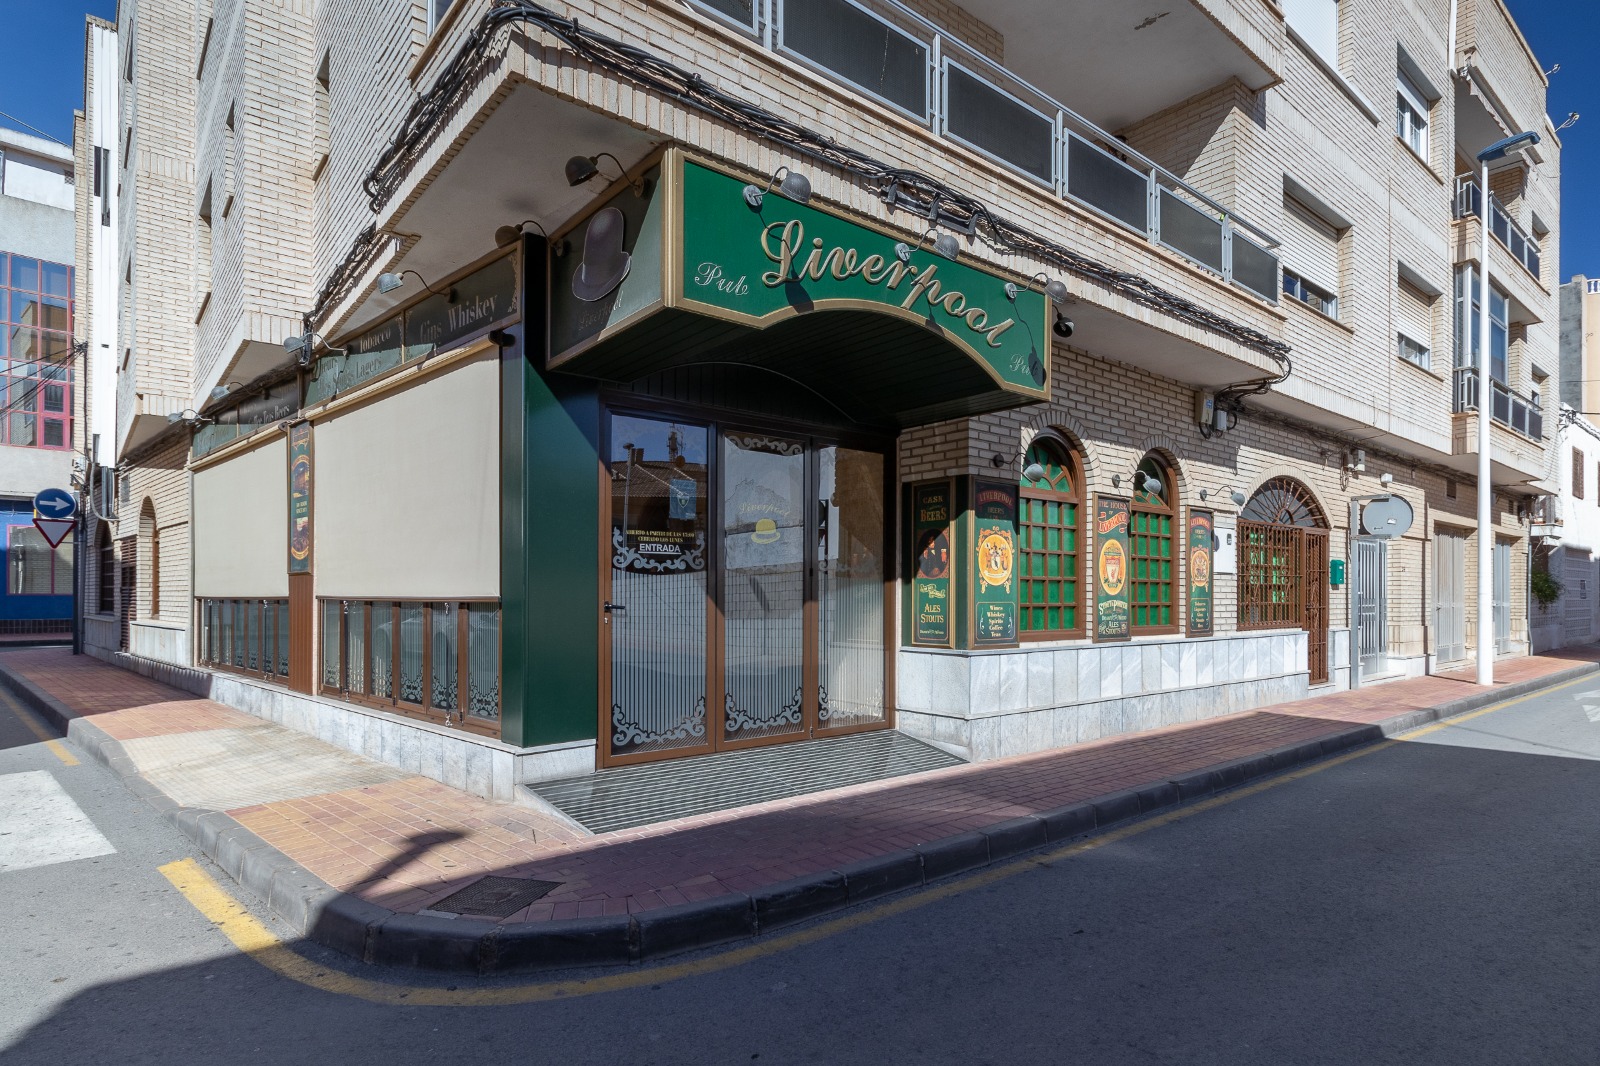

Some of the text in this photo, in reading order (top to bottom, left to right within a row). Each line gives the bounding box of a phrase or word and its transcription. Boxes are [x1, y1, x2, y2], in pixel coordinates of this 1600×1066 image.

[694, 262, 749, 296] Pub
[760, 219, 1015, 348] Liverpool
[420, 293, 498, 344] Gins Whiskey
[359, 326, 392, 354] Tobacco
[922, 495, 945, 504] CASK
[979, 491, 1013, 506] LIVERPOOL
[920, 507, 947, 522] BEERS
[639, 543, 681, 552] ENTRADA
[924, 602, 941, 613] ALES
[986, 611, 1005, 619] Whiskey
[920, 613, 944, 624] STOUTS
